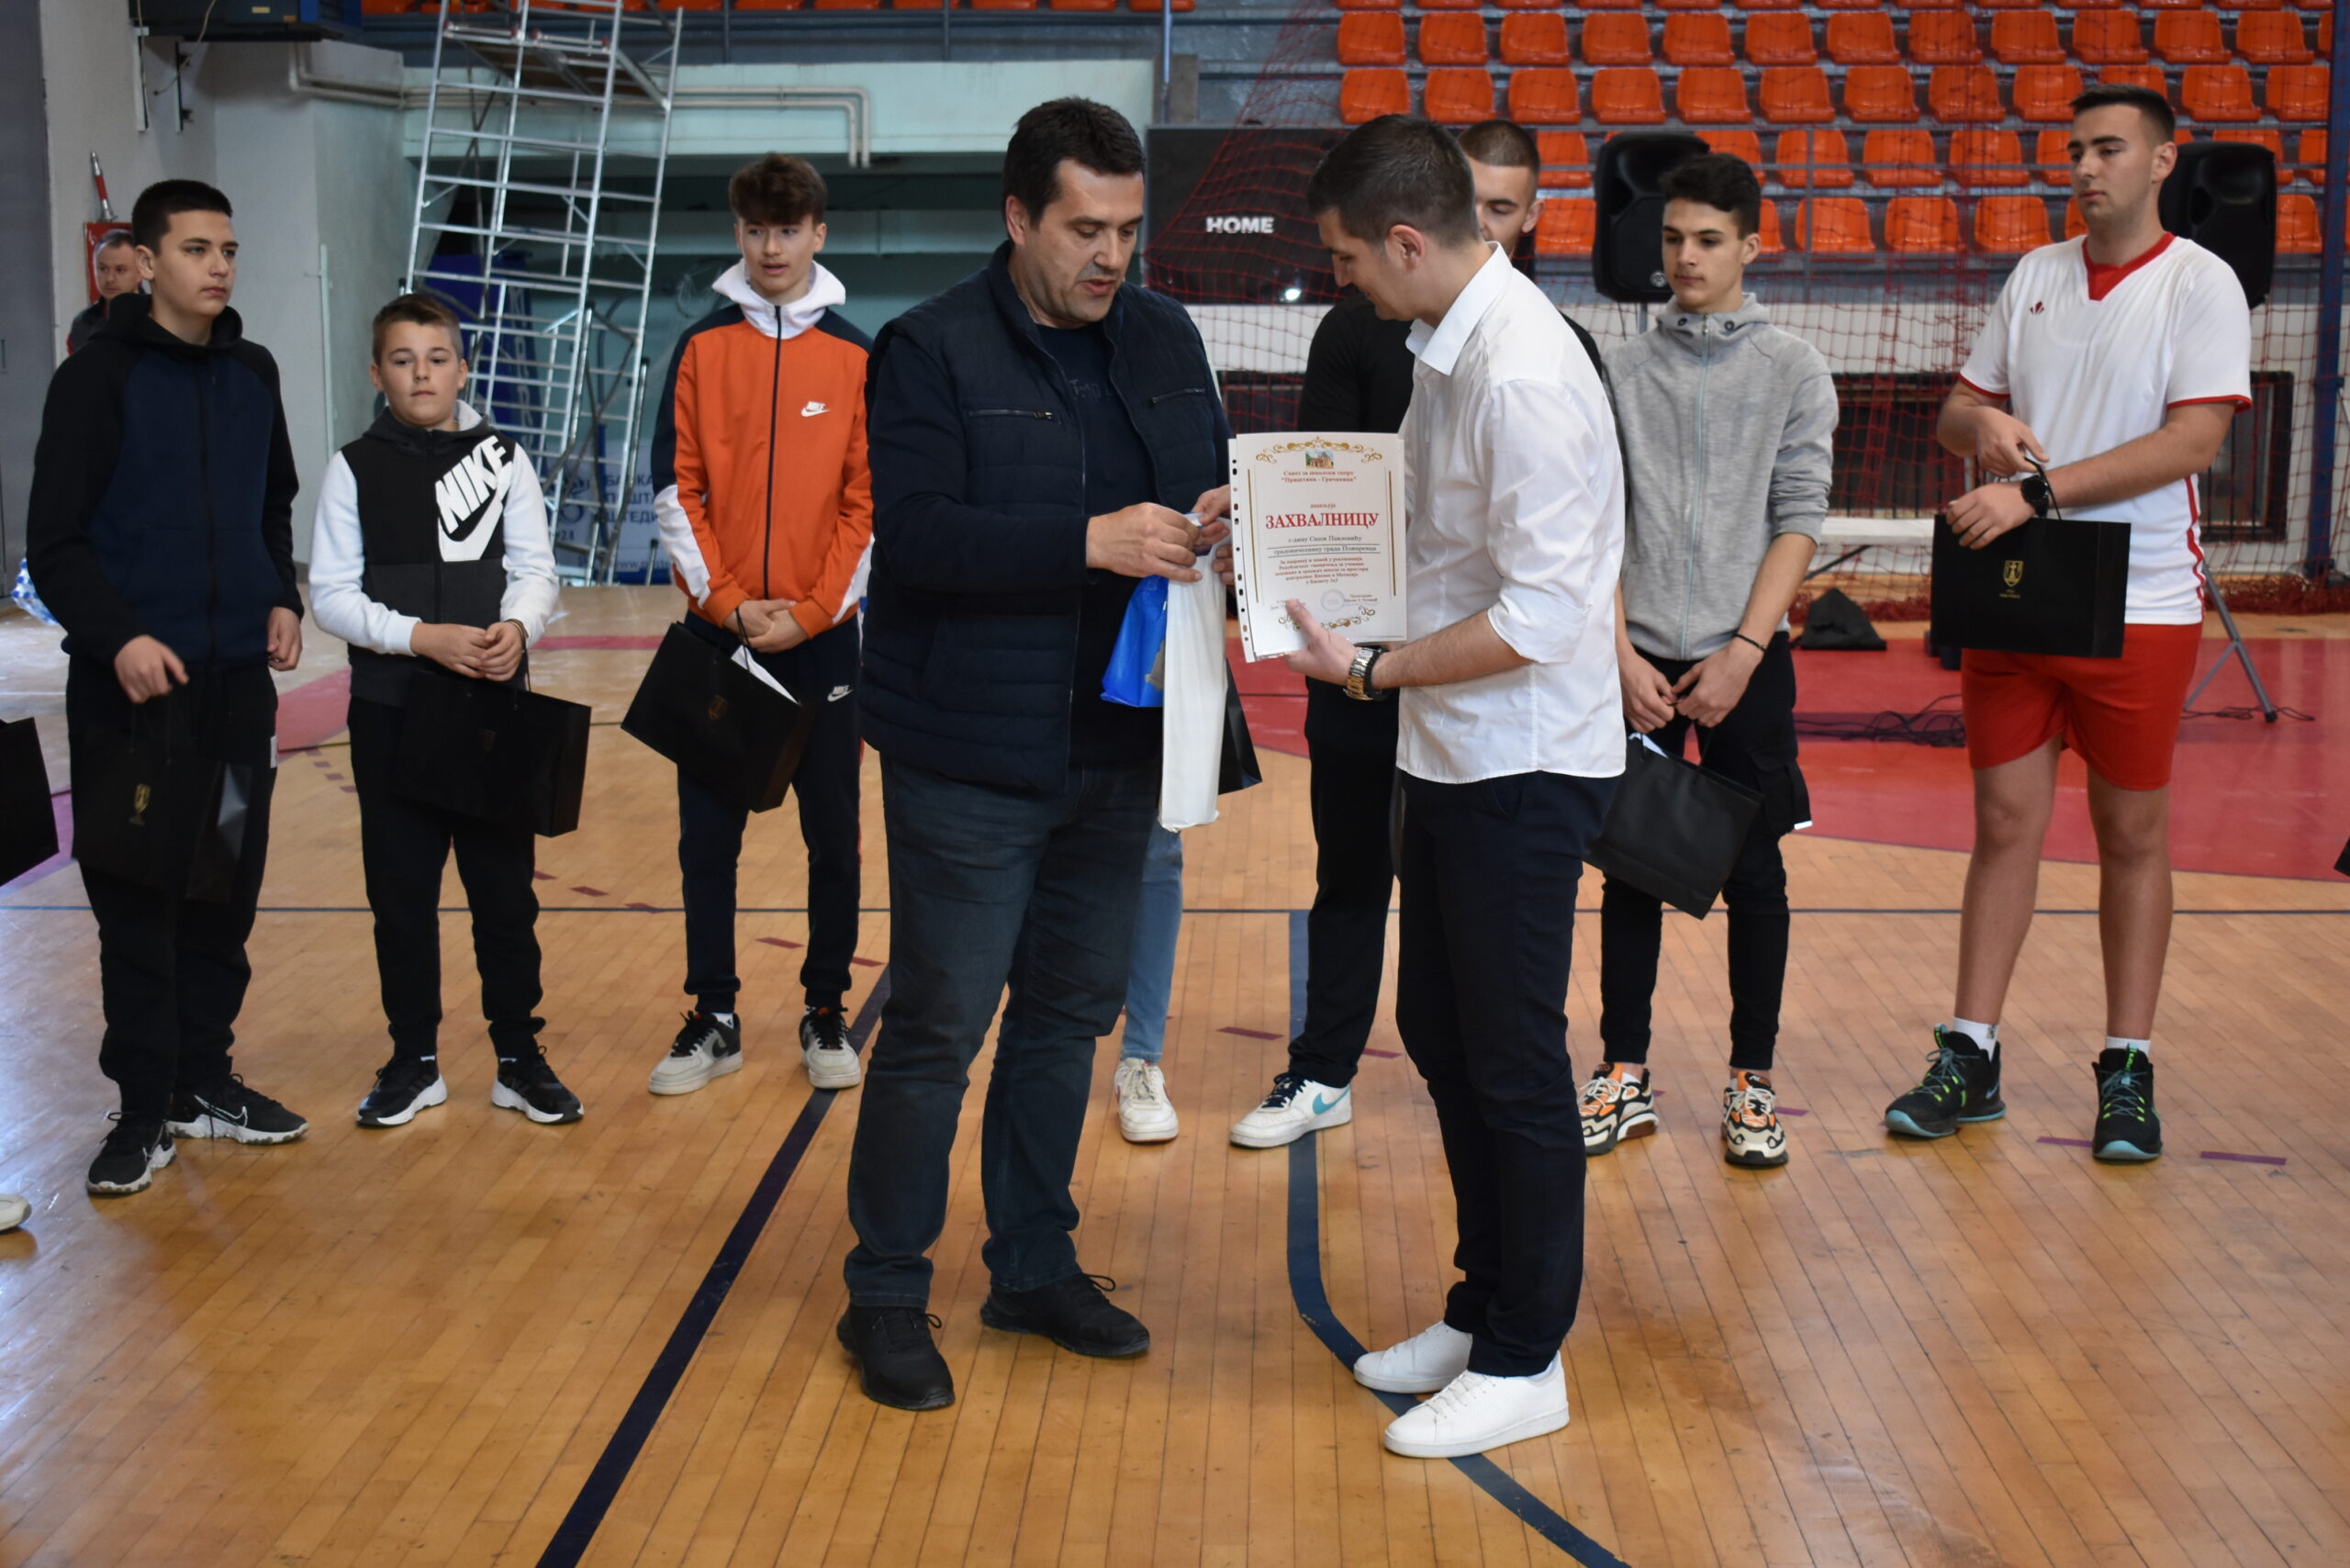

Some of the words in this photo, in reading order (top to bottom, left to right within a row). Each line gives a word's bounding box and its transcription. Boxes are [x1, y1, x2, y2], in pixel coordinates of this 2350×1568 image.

[1206, 216, 1274, 233] HOME
[435, 435, 513, 534] NIKE
[1266, 513, 1379, 529] ЗАХВАЛНИЦУ
